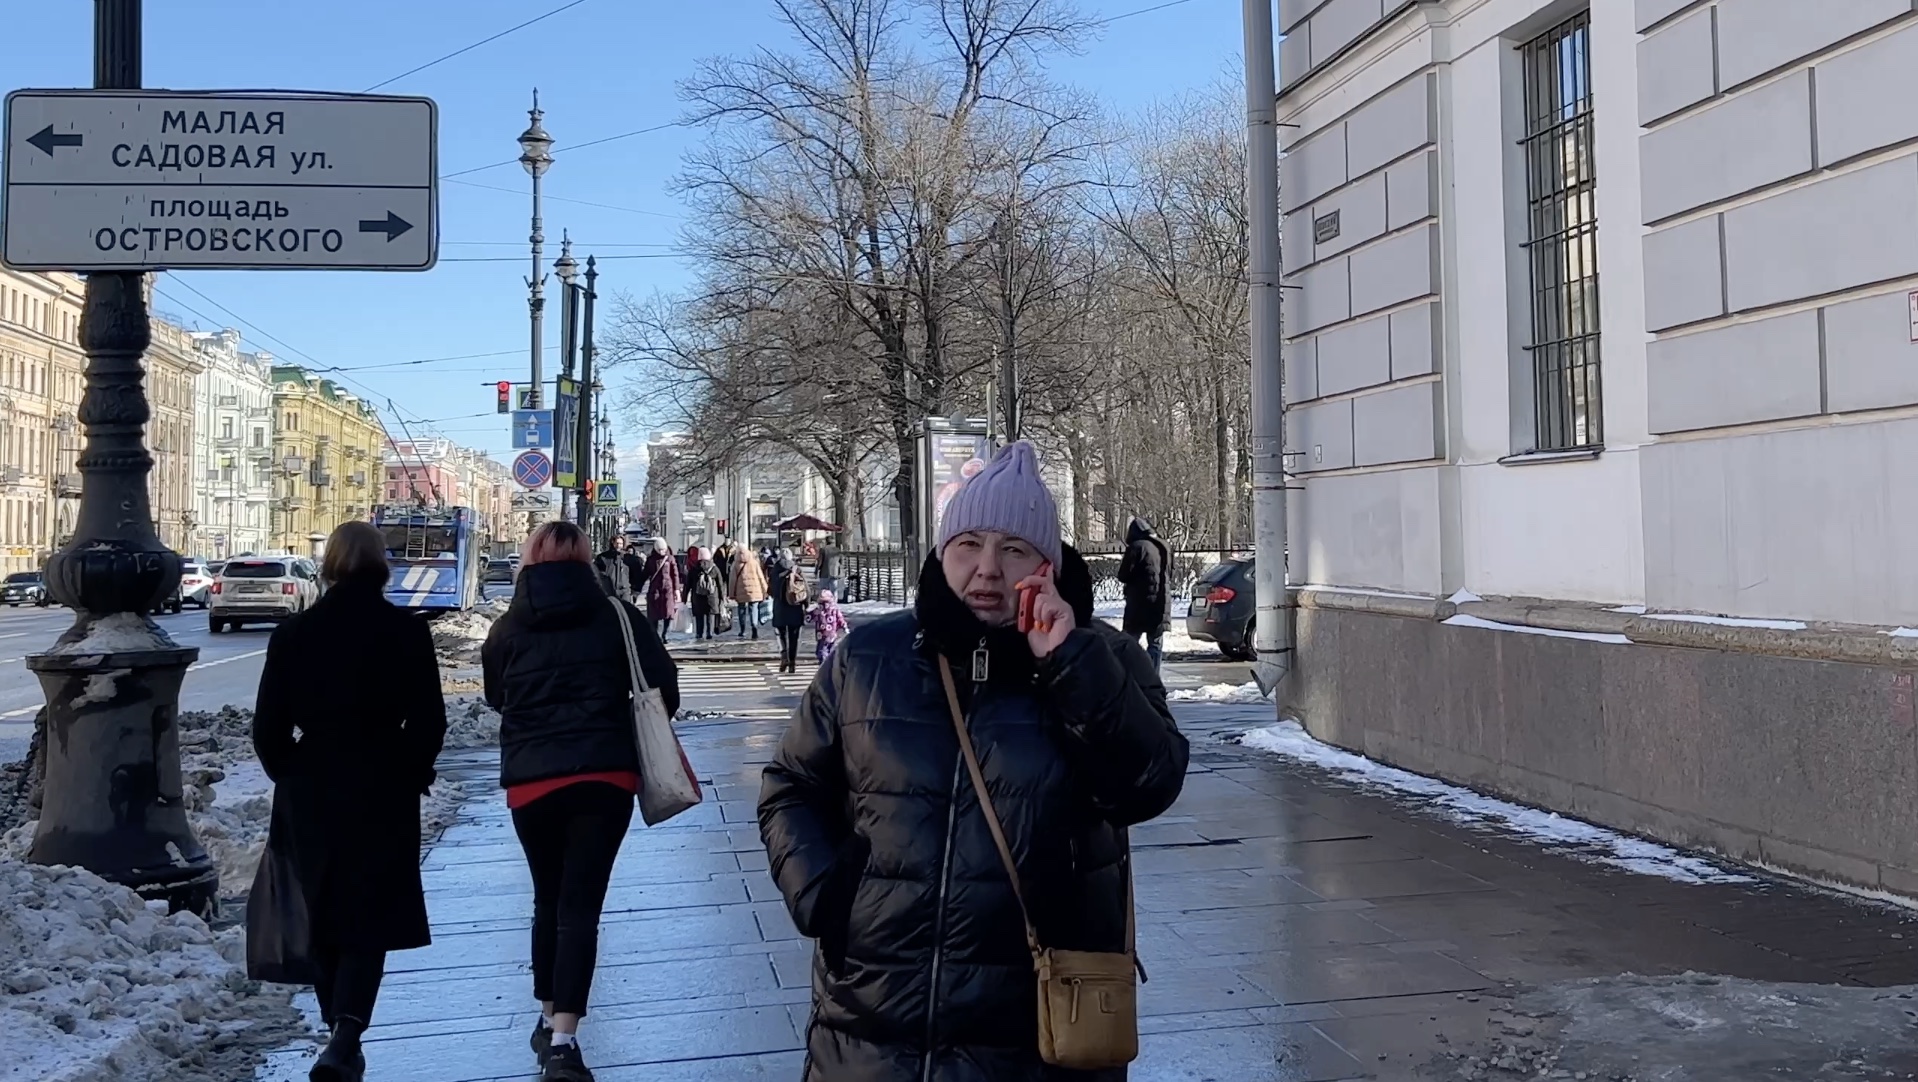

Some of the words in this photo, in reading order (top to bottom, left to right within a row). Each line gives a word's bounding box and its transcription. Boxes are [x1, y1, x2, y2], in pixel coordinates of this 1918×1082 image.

[161, 110, 284, 135] МАЛАЯ
[111, 143, 275, 171] САДОВАЯ
[291, 151, 333, 174] ул.
[150, 199, 289, 220] площадь
[95, 227, 342, 253] ОСТРОВСКОГО
